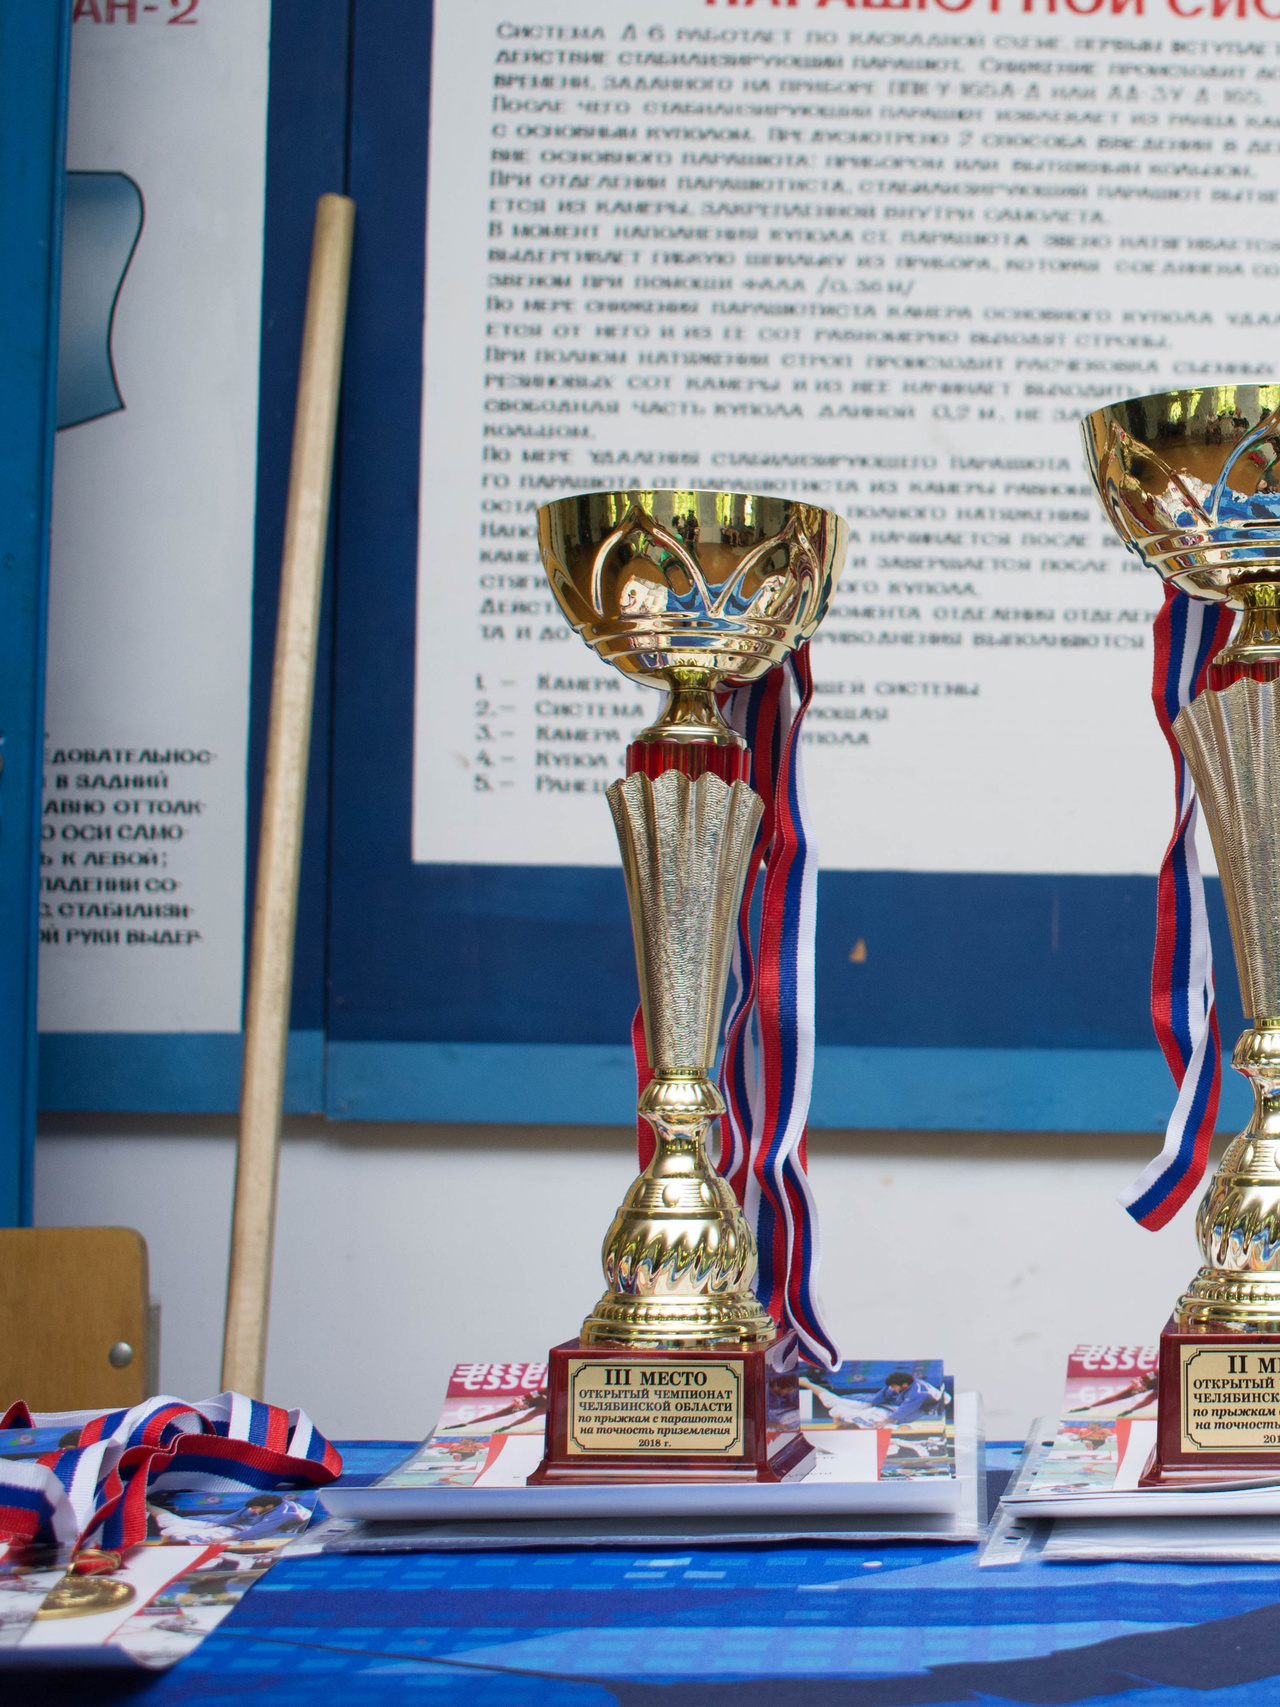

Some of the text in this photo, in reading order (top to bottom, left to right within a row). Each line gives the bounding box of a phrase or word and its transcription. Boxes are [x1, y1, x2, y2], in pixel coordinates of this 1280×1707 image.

[496, 22, 606, 43] СИСТЕМА
[491, 97, 565, 115] ПОСЛЕ
[490, 171, 532, 189] ПРИ
[486, 295, 515, 314] ПО
[552, 323, 581, 340] ОТ
[485, 346, 526, 365] ПРИ
[537, 673, 620, 691] КАМЕРА
[535, 700, 645, 718] СИСТЕМА
[536, 727, 620, 744] КАМЕРА
[56, 769, 168, 789] В ЗАДНИЙ
[61, 825, 112, 841] ОСИ
[62, 852, 75, 866] К
[66, 928, 119, 944] РУКИ
[1228, 1354, 1247, 1375] II
[605, 1368, 708, 1387] III МЕСТО
[1193, 1377, 1274, 1389] ОТКРЫТЫЙ
[579, 1388, 732, 1399] ОТКРЫТЫЙ ЧЕМПИОНАТ
[579, 1401, 733, 1412] ЧЕЛЯБИНСКОЙ ОБЛАСТИ
[1193, 1407, 1208, 1417] по
[1211, 1407, 1276, 1419] прыжкам
[578, 1414, 733, 1426] по прыжкам с парашютом
[1195, 1420, 1211, 1430] на
[1214, 1420, 1280, 1430] точность
[580, 1426, 730, 1438] на точность приземления
[638, 1438, 673, 1449] 2018 г.
